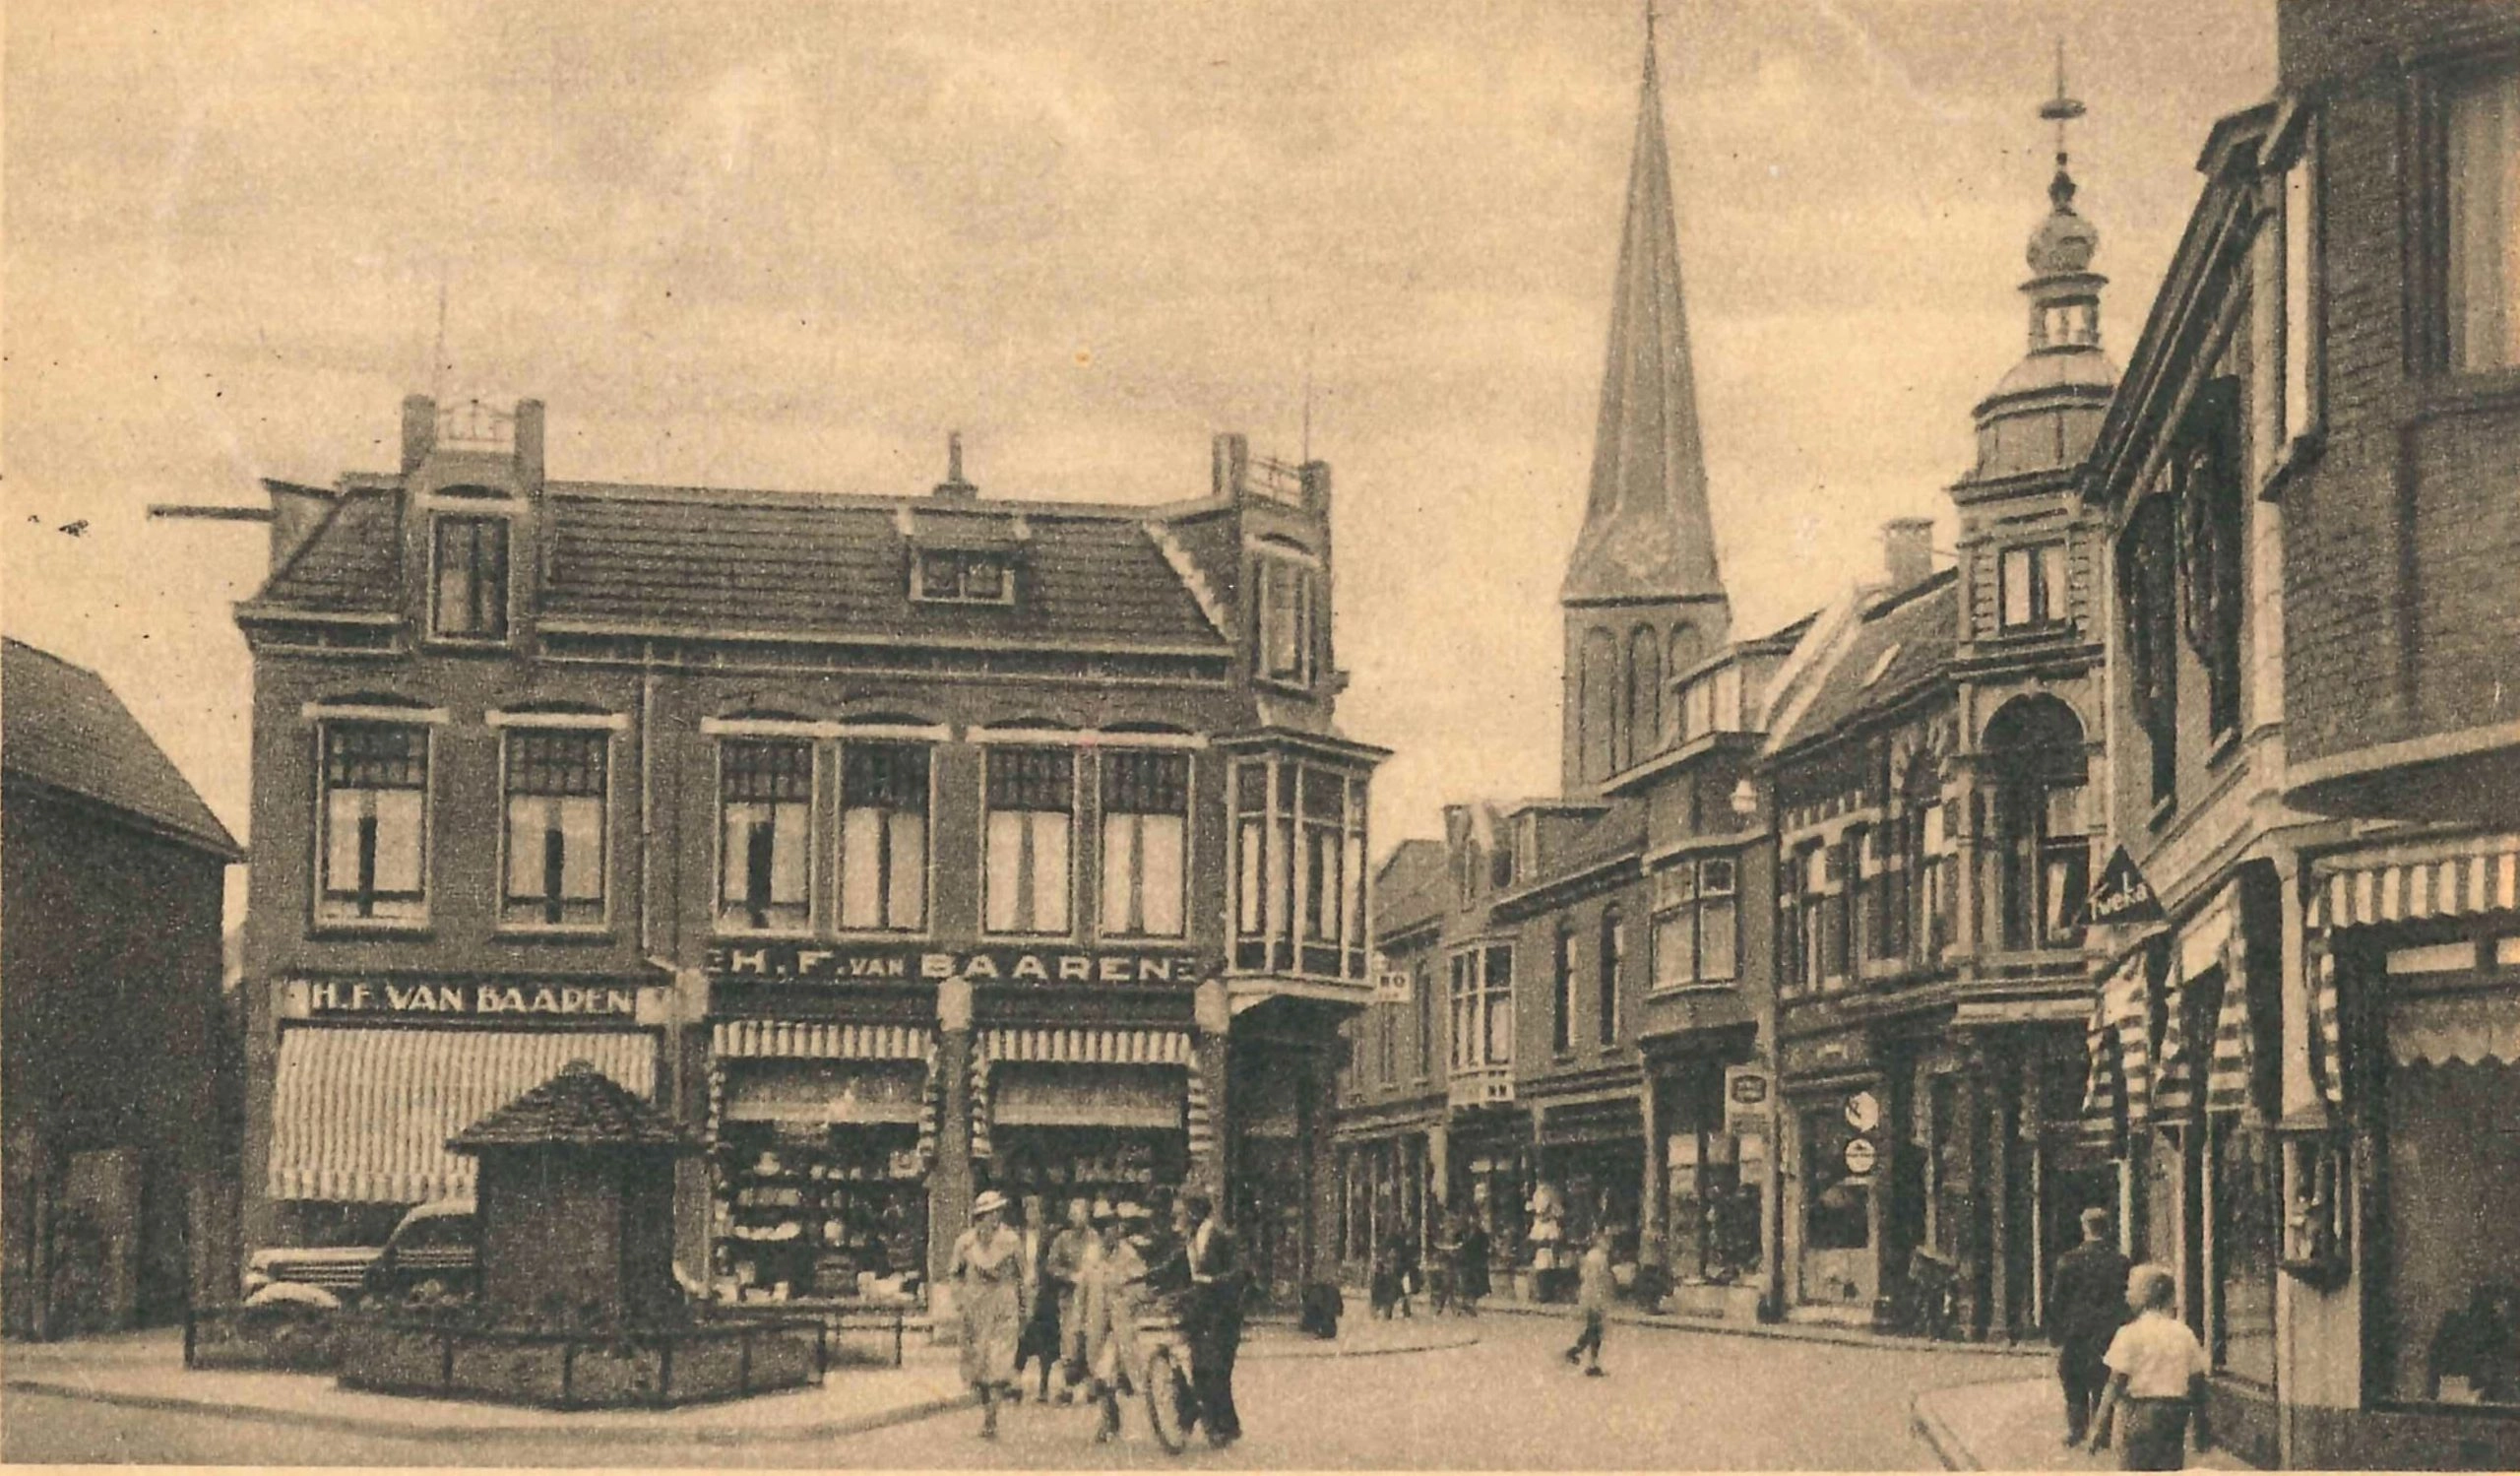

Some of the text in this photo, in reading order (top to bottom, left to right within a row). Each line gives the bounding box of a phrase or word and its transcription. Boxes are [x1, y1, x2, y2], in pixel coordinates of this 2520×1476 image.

[2088, 870, 2149, 920] Tweka
[850, 958, 904, 977] VAN
[921, 953, 1170, 980] BAAREN
[385, 983, 465, 1011] VAN
